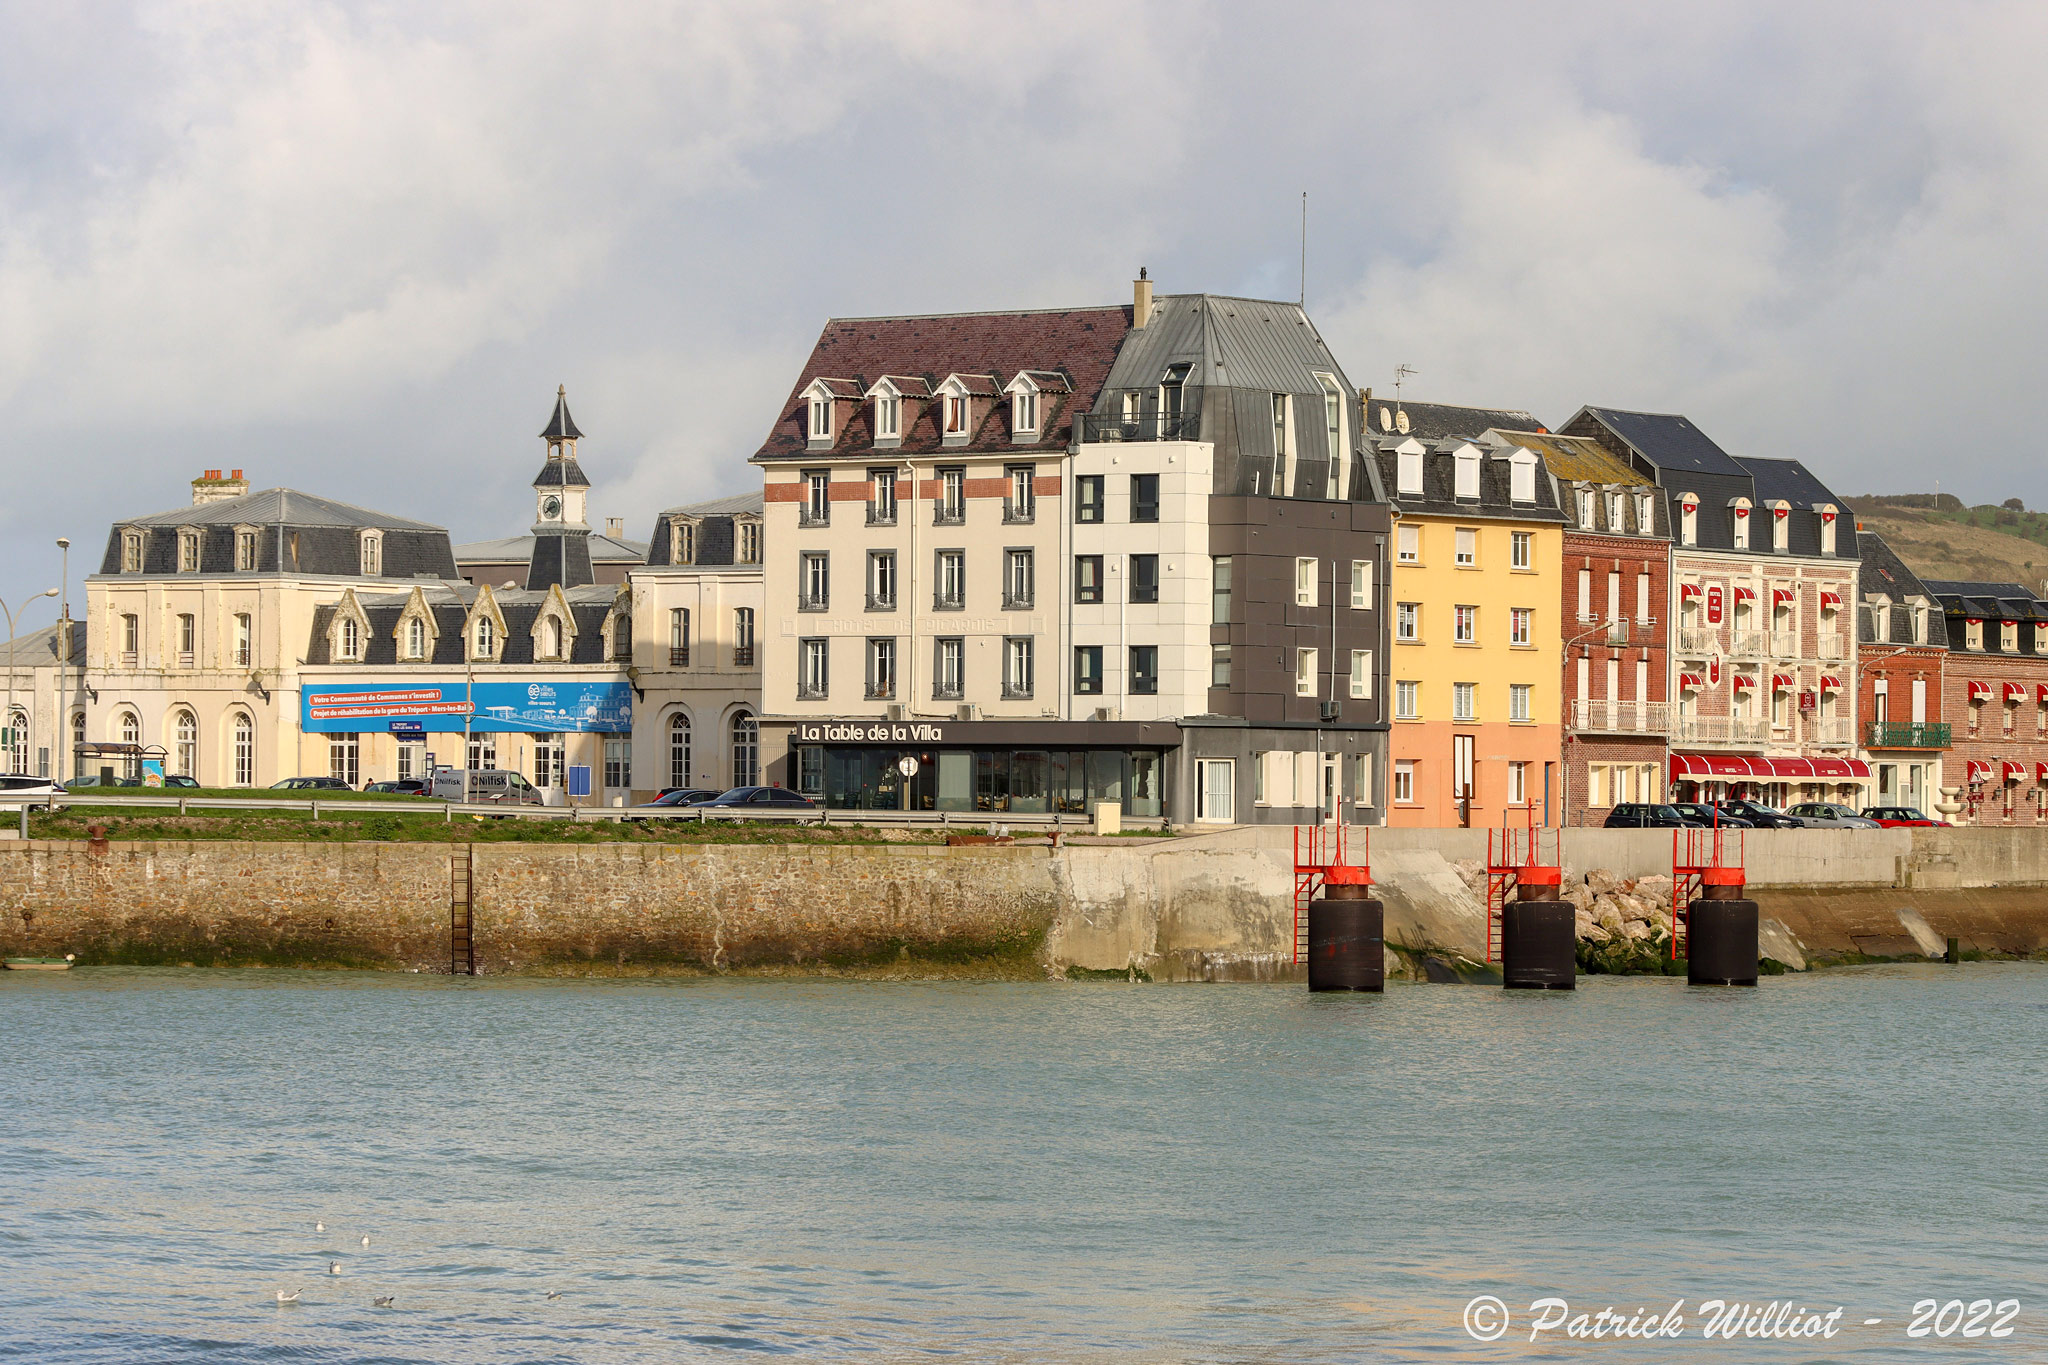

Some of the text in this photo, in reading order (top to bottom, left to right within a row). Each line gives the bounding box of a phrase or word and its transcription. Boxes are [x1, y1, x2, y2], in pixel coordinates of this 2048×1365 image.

[925, 618, 995, 632] PICARDIE
[330, 694, 368, 703] Communauté
[368, 693, 376, 701] de
[376, 692, 408, 701] Communes
[313, 709, 330, 718] Projet
[330, 708, 337, 716] de
[338, 707, 373, 716] réhabilitation
[387, 707, 399, 716] gare
[408, 705, 428, 715] Tréport
[431, 703, 473, 712] Mers-les-Bais
[801, 724, 942, 741] La Table de la Villa
[478, 775, 507, 786] Nilfisk
